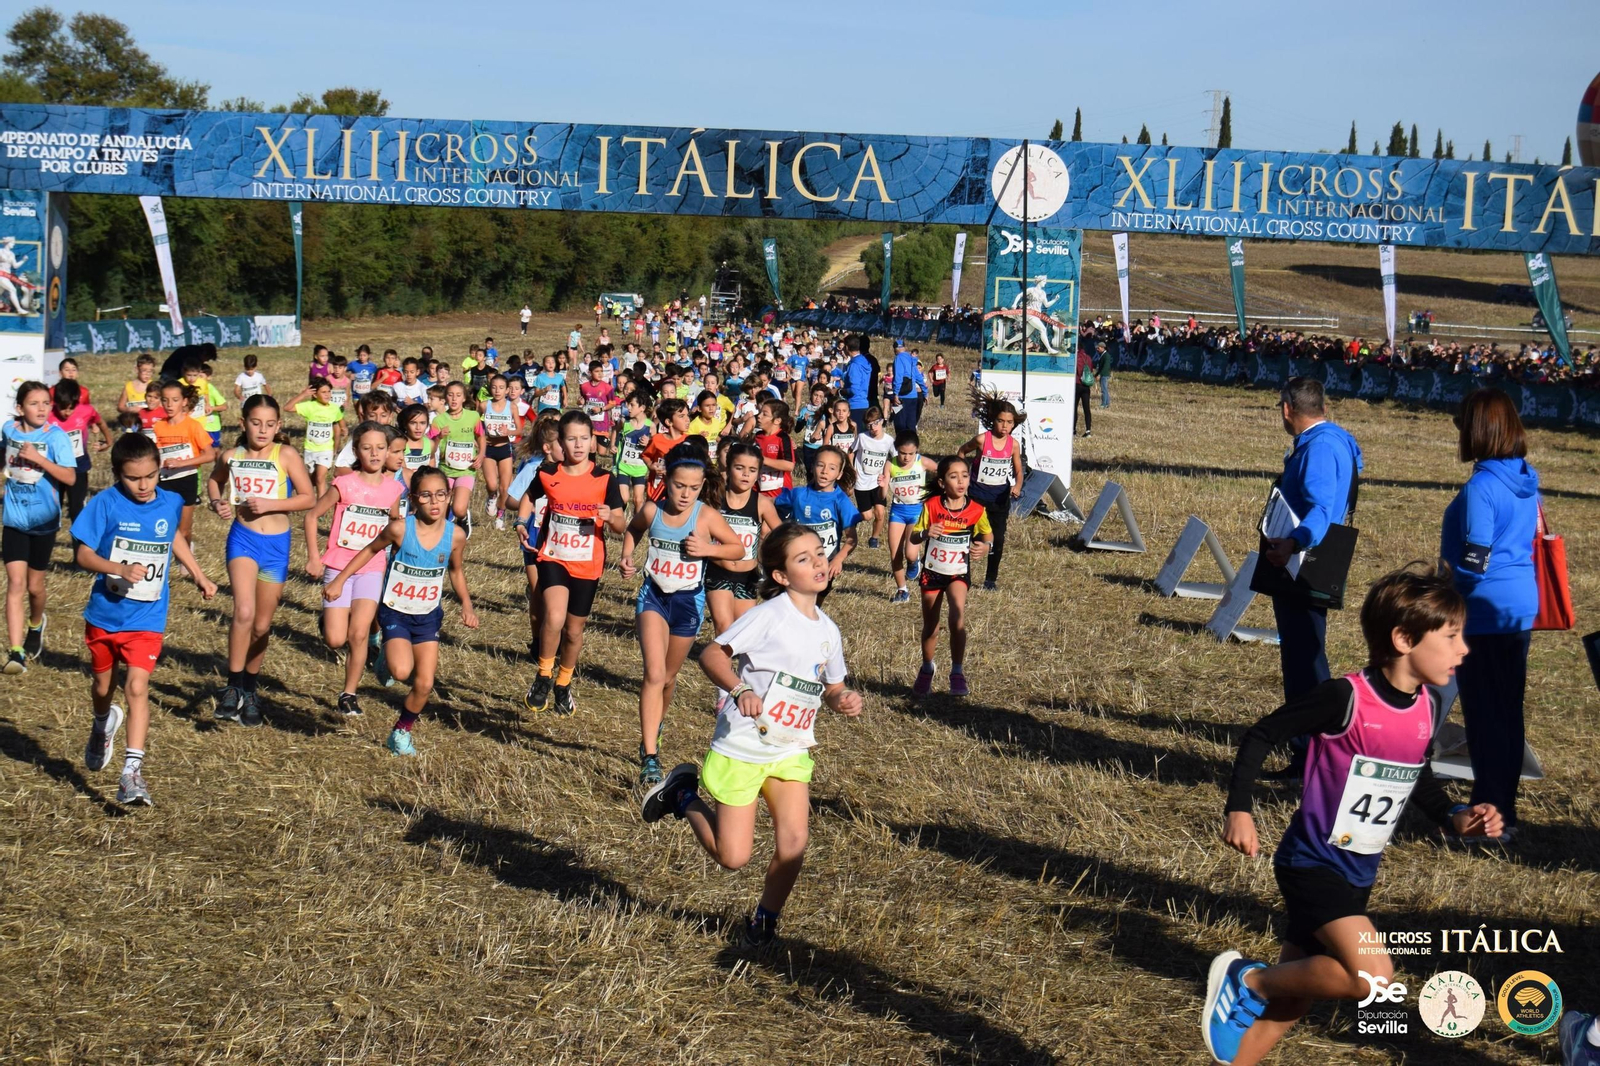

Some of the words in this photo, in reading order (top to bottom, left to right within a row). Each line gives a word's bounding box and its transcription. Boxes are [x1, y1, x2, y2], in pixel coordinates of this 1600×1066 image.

[81, 134, 100, 147] DE
[102, 134, 192, 150] ANDALUCÍA
[415, 133, 538, 166] CROSS
[7, 145, 27, 158] DE
[28, 147, 86, 159] CAMPO
[87, 149, 101, 161] A
[102, 149, 158, 163] TRAVÉS
[253, 126, 411, 182] XLIII
[41, 160, 71, 173] POR
[74, 161, 128, 175] CLUBES
[594, 127, 895, 204] ITÁLICA
[415, 167, 583, 188] INTERNACIONAL
[1112, 156, 1274, 215] XLIII
[1278, 165, 1403, 200] CROSS
[252, 182, 400, 201] INTERNATIONAL
[405, 187, 460, 204] CROSS
[465, 188, 552, 206] COUNTRY
[3, 207, 36, 217] Sevilla
[1278, 200, 1447, 224] INTERNACIONAL
[1111, 211, 1261, 234] INTERNATIONAL
[1266, 219, 1323, 237] CROSS
[1327, 222, 1417, 242] COUNTRY
[1036, 238, 1070, 247] Diputación
[1036, 246, 1069, 256] Sevilla
[309, 430, 331, 438] 4249
[448, 451, 472, 462] 4398
[863, 458, 884, 468] 4169
[982, 466, 1007, 477] 4245
[235, 476, 276, 495] 4357
[894, 485, 921, 497] 4367
[560, 517, 582, 526] ITÁLIC
[551, 531, 590, 549] 4462
[930, 547, 965, 563] 4372
[651, 558, 698, 580] 4449
[392, 581, 439, 601] 4443
[768, 700, 816, 731] 4518
